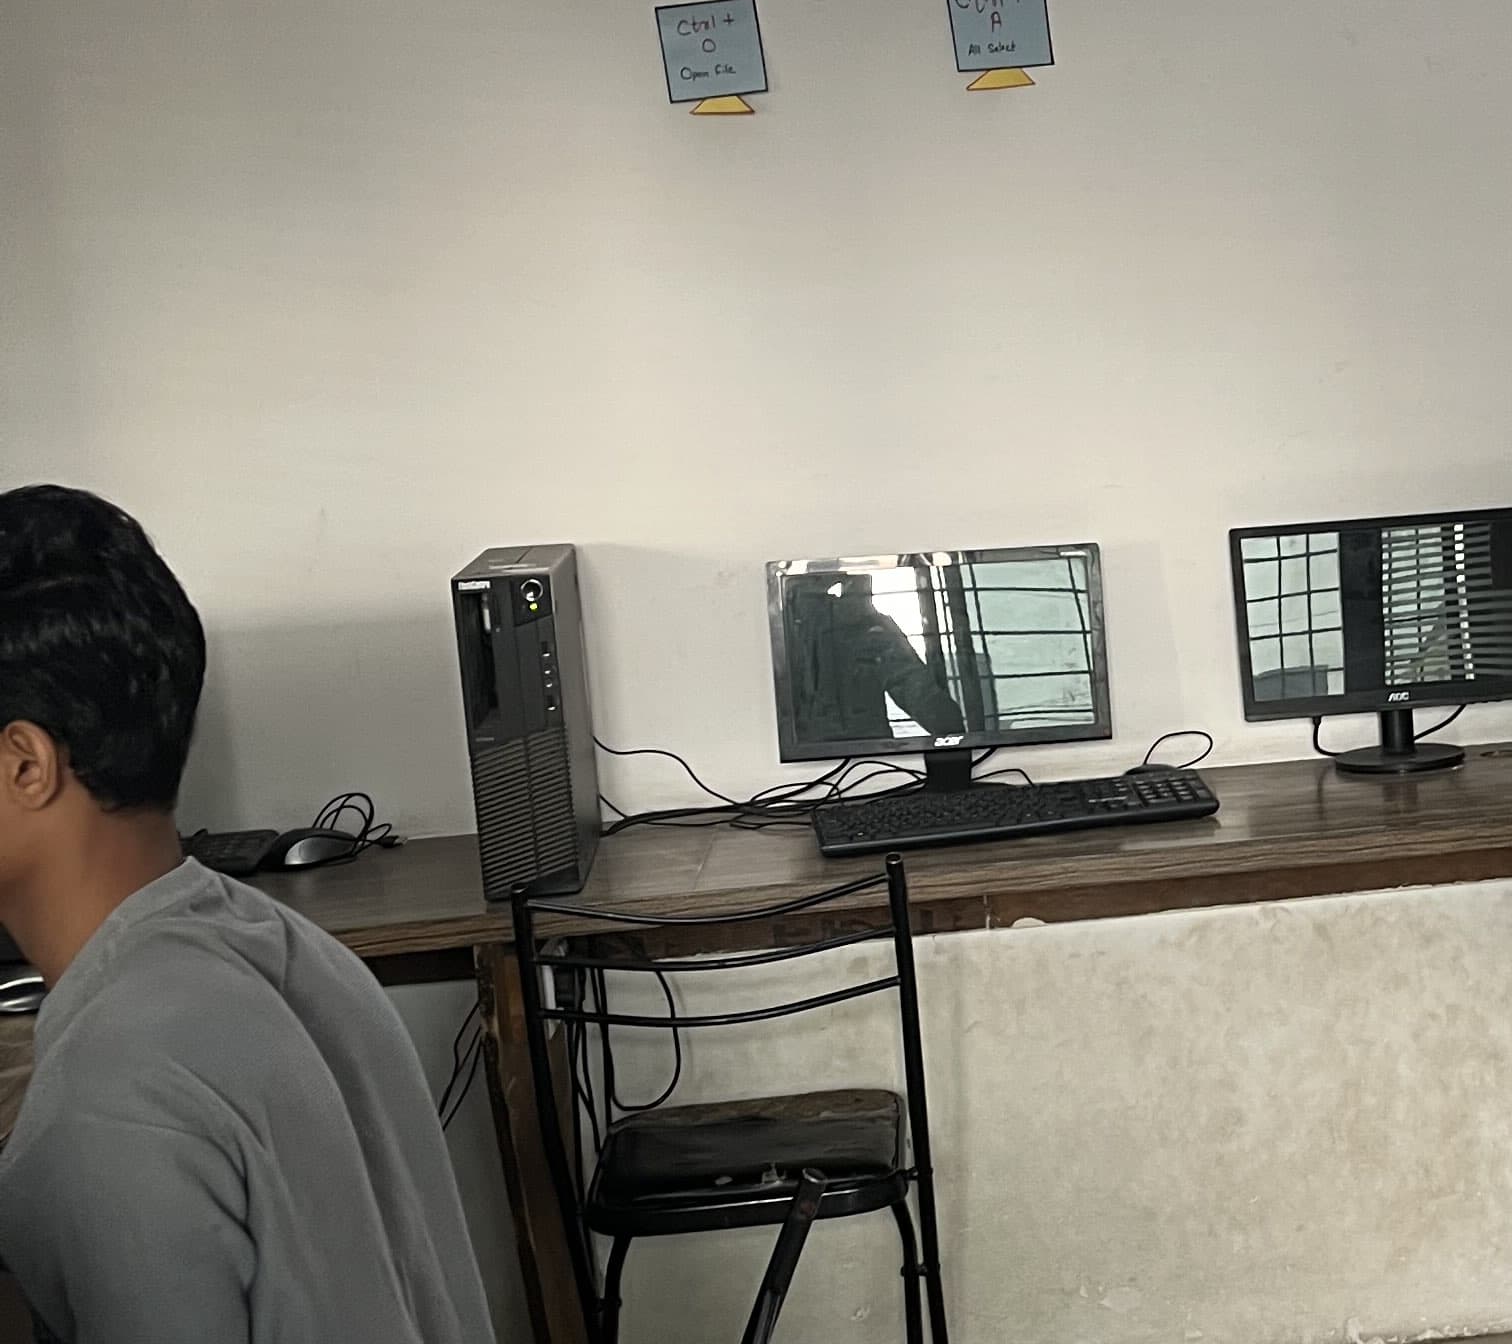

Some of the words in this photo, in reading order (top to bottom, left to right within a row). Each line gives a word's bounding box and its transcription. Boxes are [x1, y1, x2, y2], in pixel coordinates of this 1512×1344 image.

[677, 16, 716, 36] Ctrl
[723, 13, 735, 26] +
[991, 11, 1002, 33] A
